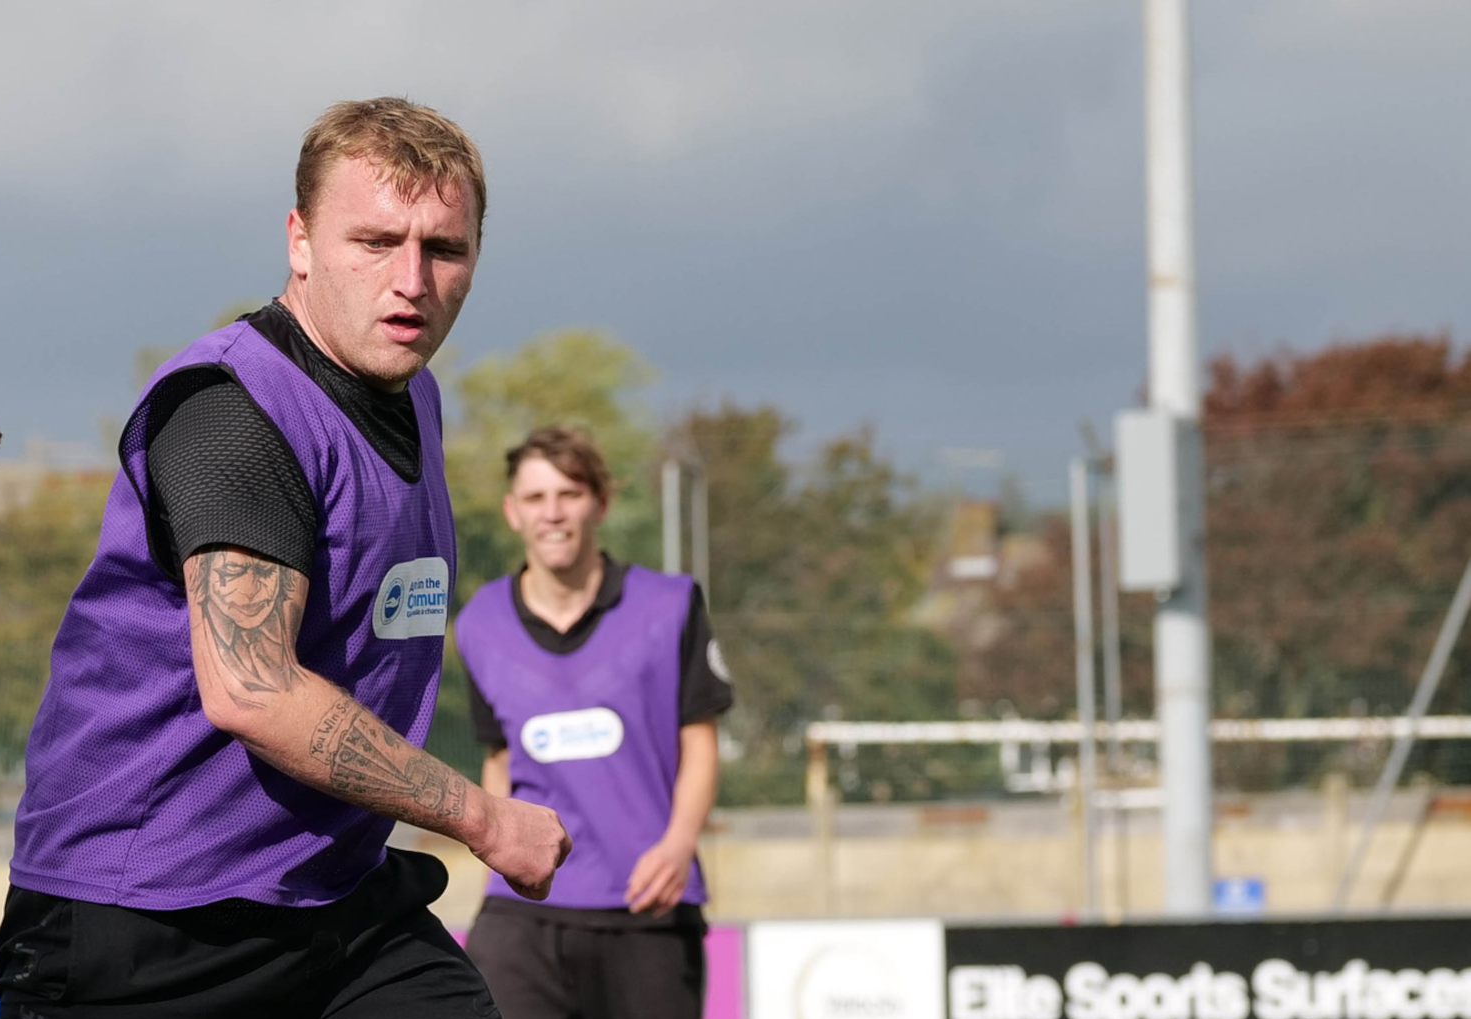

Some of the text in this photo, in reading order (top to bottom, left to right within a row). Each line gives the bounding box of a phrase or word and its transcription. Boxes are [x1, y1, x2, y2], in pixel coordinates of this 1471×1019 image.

[425, 577, 441, 589] the
[311, 737, 325, 755] You
[318, 715, 339, 734] Win
